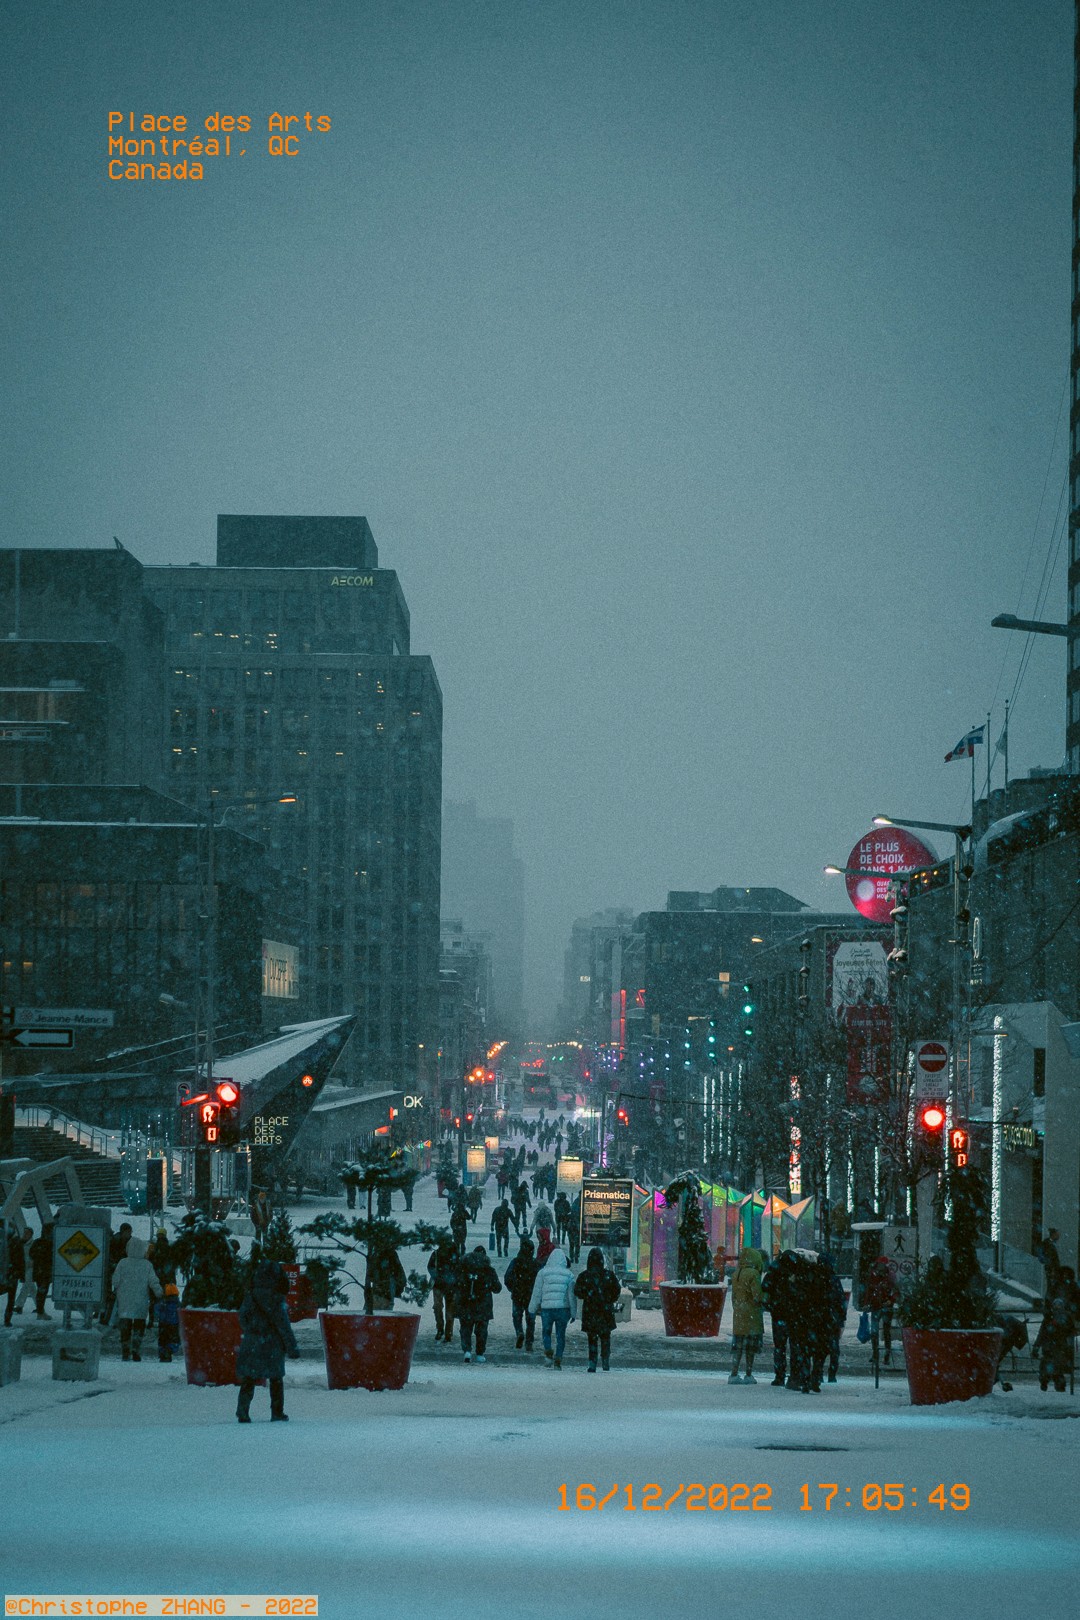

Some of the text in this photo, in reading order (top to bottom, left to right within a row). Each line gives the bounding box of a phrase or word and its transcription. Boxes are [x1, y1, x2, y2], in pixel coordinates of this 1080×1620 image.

[331, 576, 373, 586] AECOM
[860, 842, 900, 853] LE PLUS
[860, 853, 904, 864] DE CHOIX
[37, 1014, 109, 1024] Jeanne-Mance
[404, 1095, 424, 1108] OK
[254, 1116, 289, 1126] PLACE
[254, 1126, 276, 1135] DES
[254, 1135, 282, 1145] ARTS
[584, 1189, 630, 1200] Prismatica
